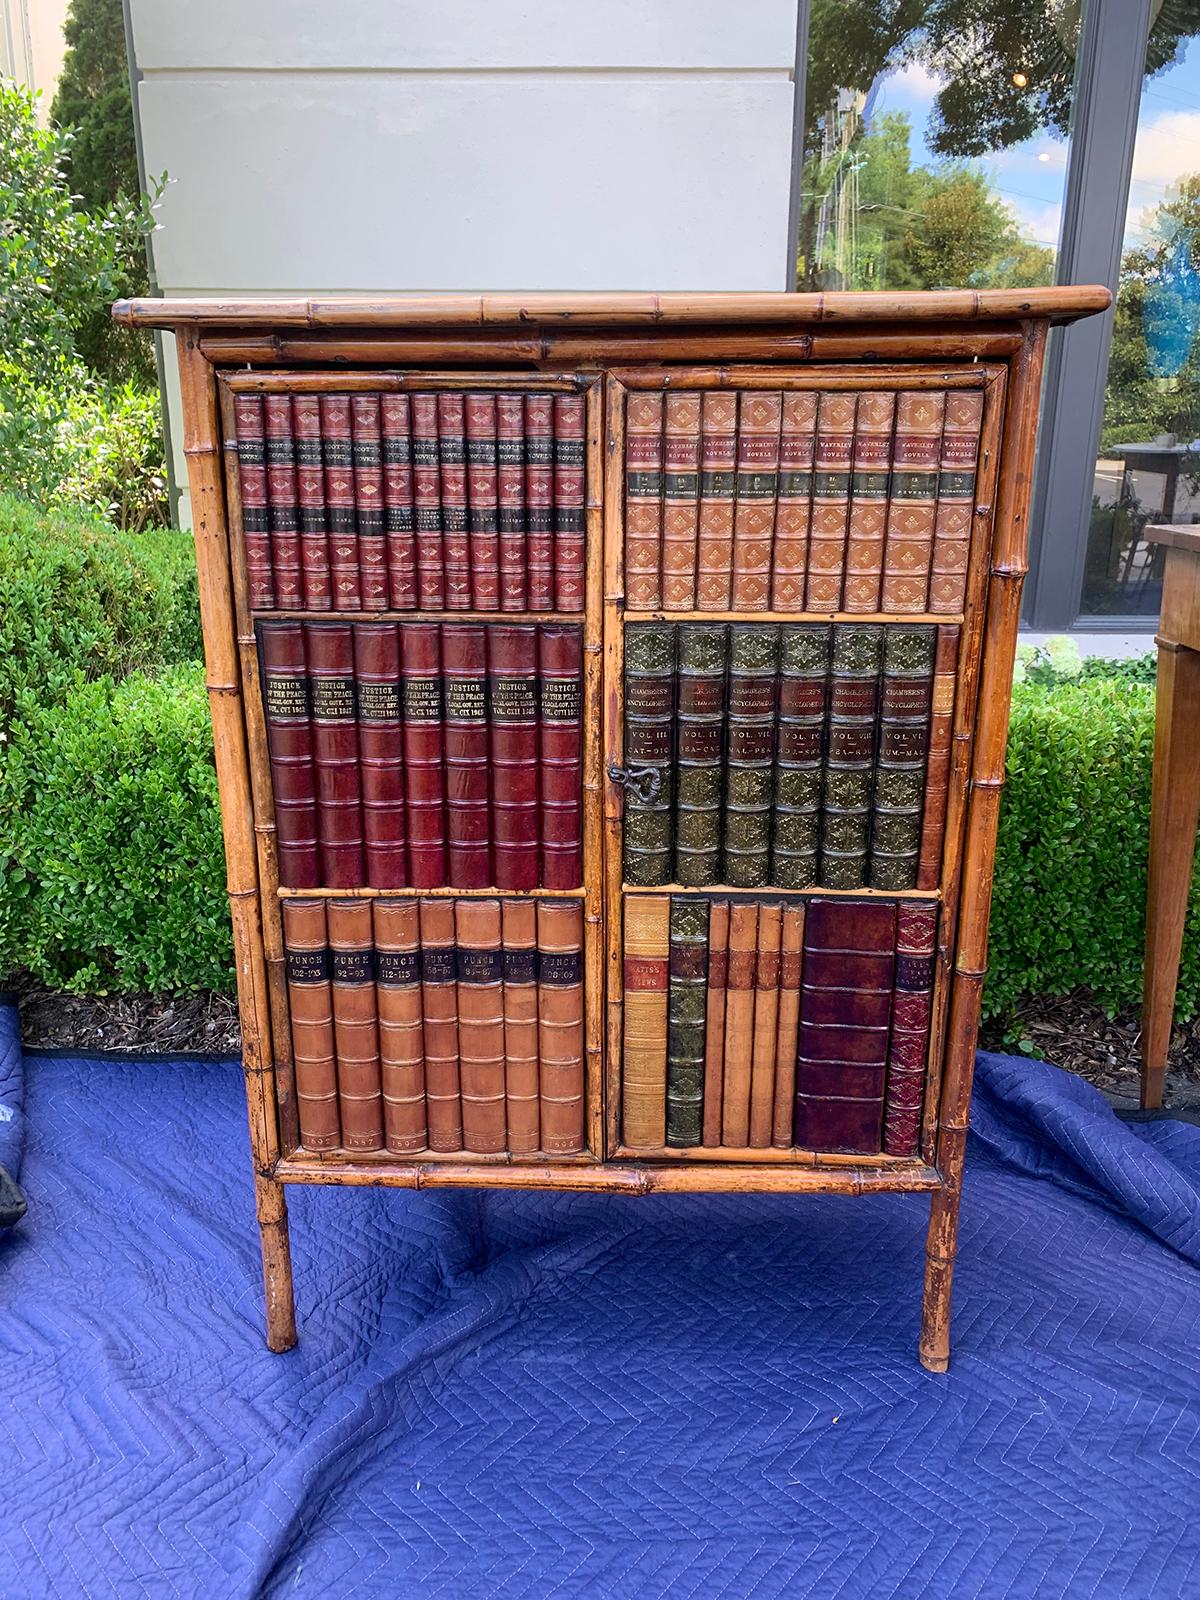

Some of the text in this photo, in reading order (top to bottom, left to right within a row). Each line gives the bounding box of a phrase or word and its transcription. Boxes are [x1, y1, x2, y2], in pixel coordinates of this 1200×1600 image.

[270, 682, 301, 690] JUSTICE
[318, 682, 346, 690] JUSTICE
[406, 682, 434, 690] JUSTICE
[450, 684, 481, 692] JUSTICE
[499, 683, 527, 691] JUSTICE
[546, 684, 577, 692] JUSTICE
[286, 690, 306, 698] PEACE
[320, 691, 333, 699] THE
[334, 690, 353, 698] PEACE
[361, 687, 393, 695] JUSTICE
[466, 693, 485, 701] PEACE
[549, 693, 562, 701] THE
[314, 707, 326, 715] VOL.
[459, 709, 470, 717] CIX
[493, 707, 506, 715] VOL.
[506, 707, 520, 715] CXII
[632, 731, 654, 739] VOL.
[732, 731, 753, 739] VOL.
[785, 733, 807, 741] VOL.
[289, 955, 322, 964] PUNCH
[334, 955, 369, 965] PUNCH
[380, 957, 416, 966] PUNCH
[464, 955, 494, 965] PUNCH
[542, 957, 577, 966] PUNCH
[292, 969, 321, 978] 102-103
[382, 970, 412, 979] 112-113
